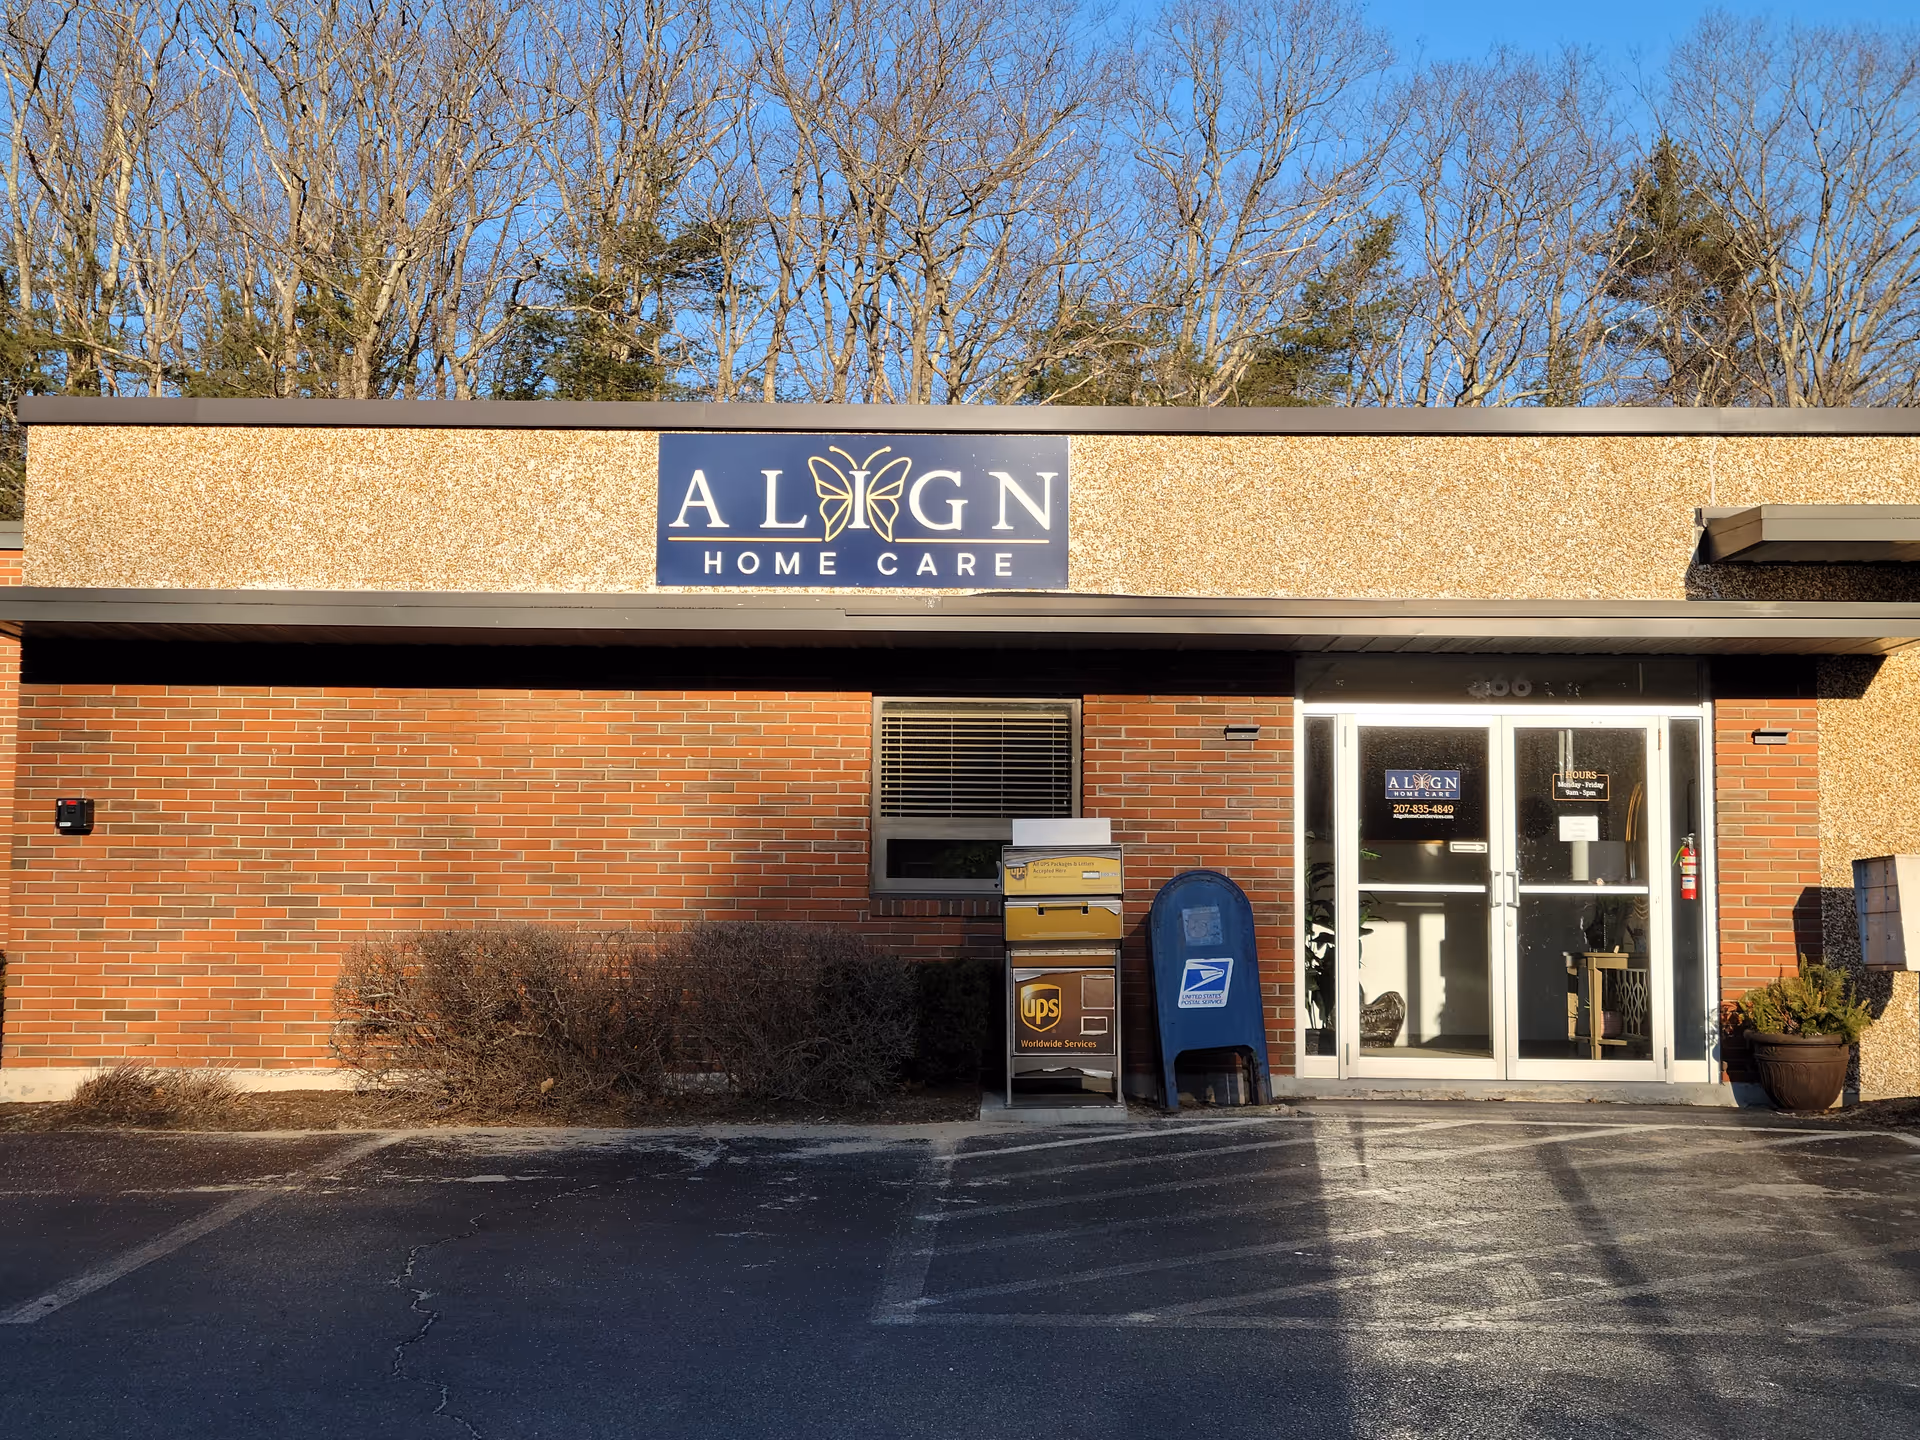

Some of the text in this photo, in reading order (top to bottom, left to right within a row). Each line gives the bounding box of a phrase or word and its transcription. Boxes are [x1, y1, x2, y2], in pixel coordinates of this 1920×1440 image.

[668, 469, 1059, 531] ALIGN
[704, 551, 1013, 577] HOME CARE
[1565, 770, 1597, 780] HOURS
[1388, 776, 1458, 789] ALIGN
[1557, 781, 1582, 789] Monday
[1585, 781, 1604, 790] Friday
[1583, 789, 1596, 797] 5pm
[1393, 804, 1454, 814] 207-835-4849
[1023, 998, 1059, 1025] ups
[1021, 1039, 1097, 1048] Worldwide Services
